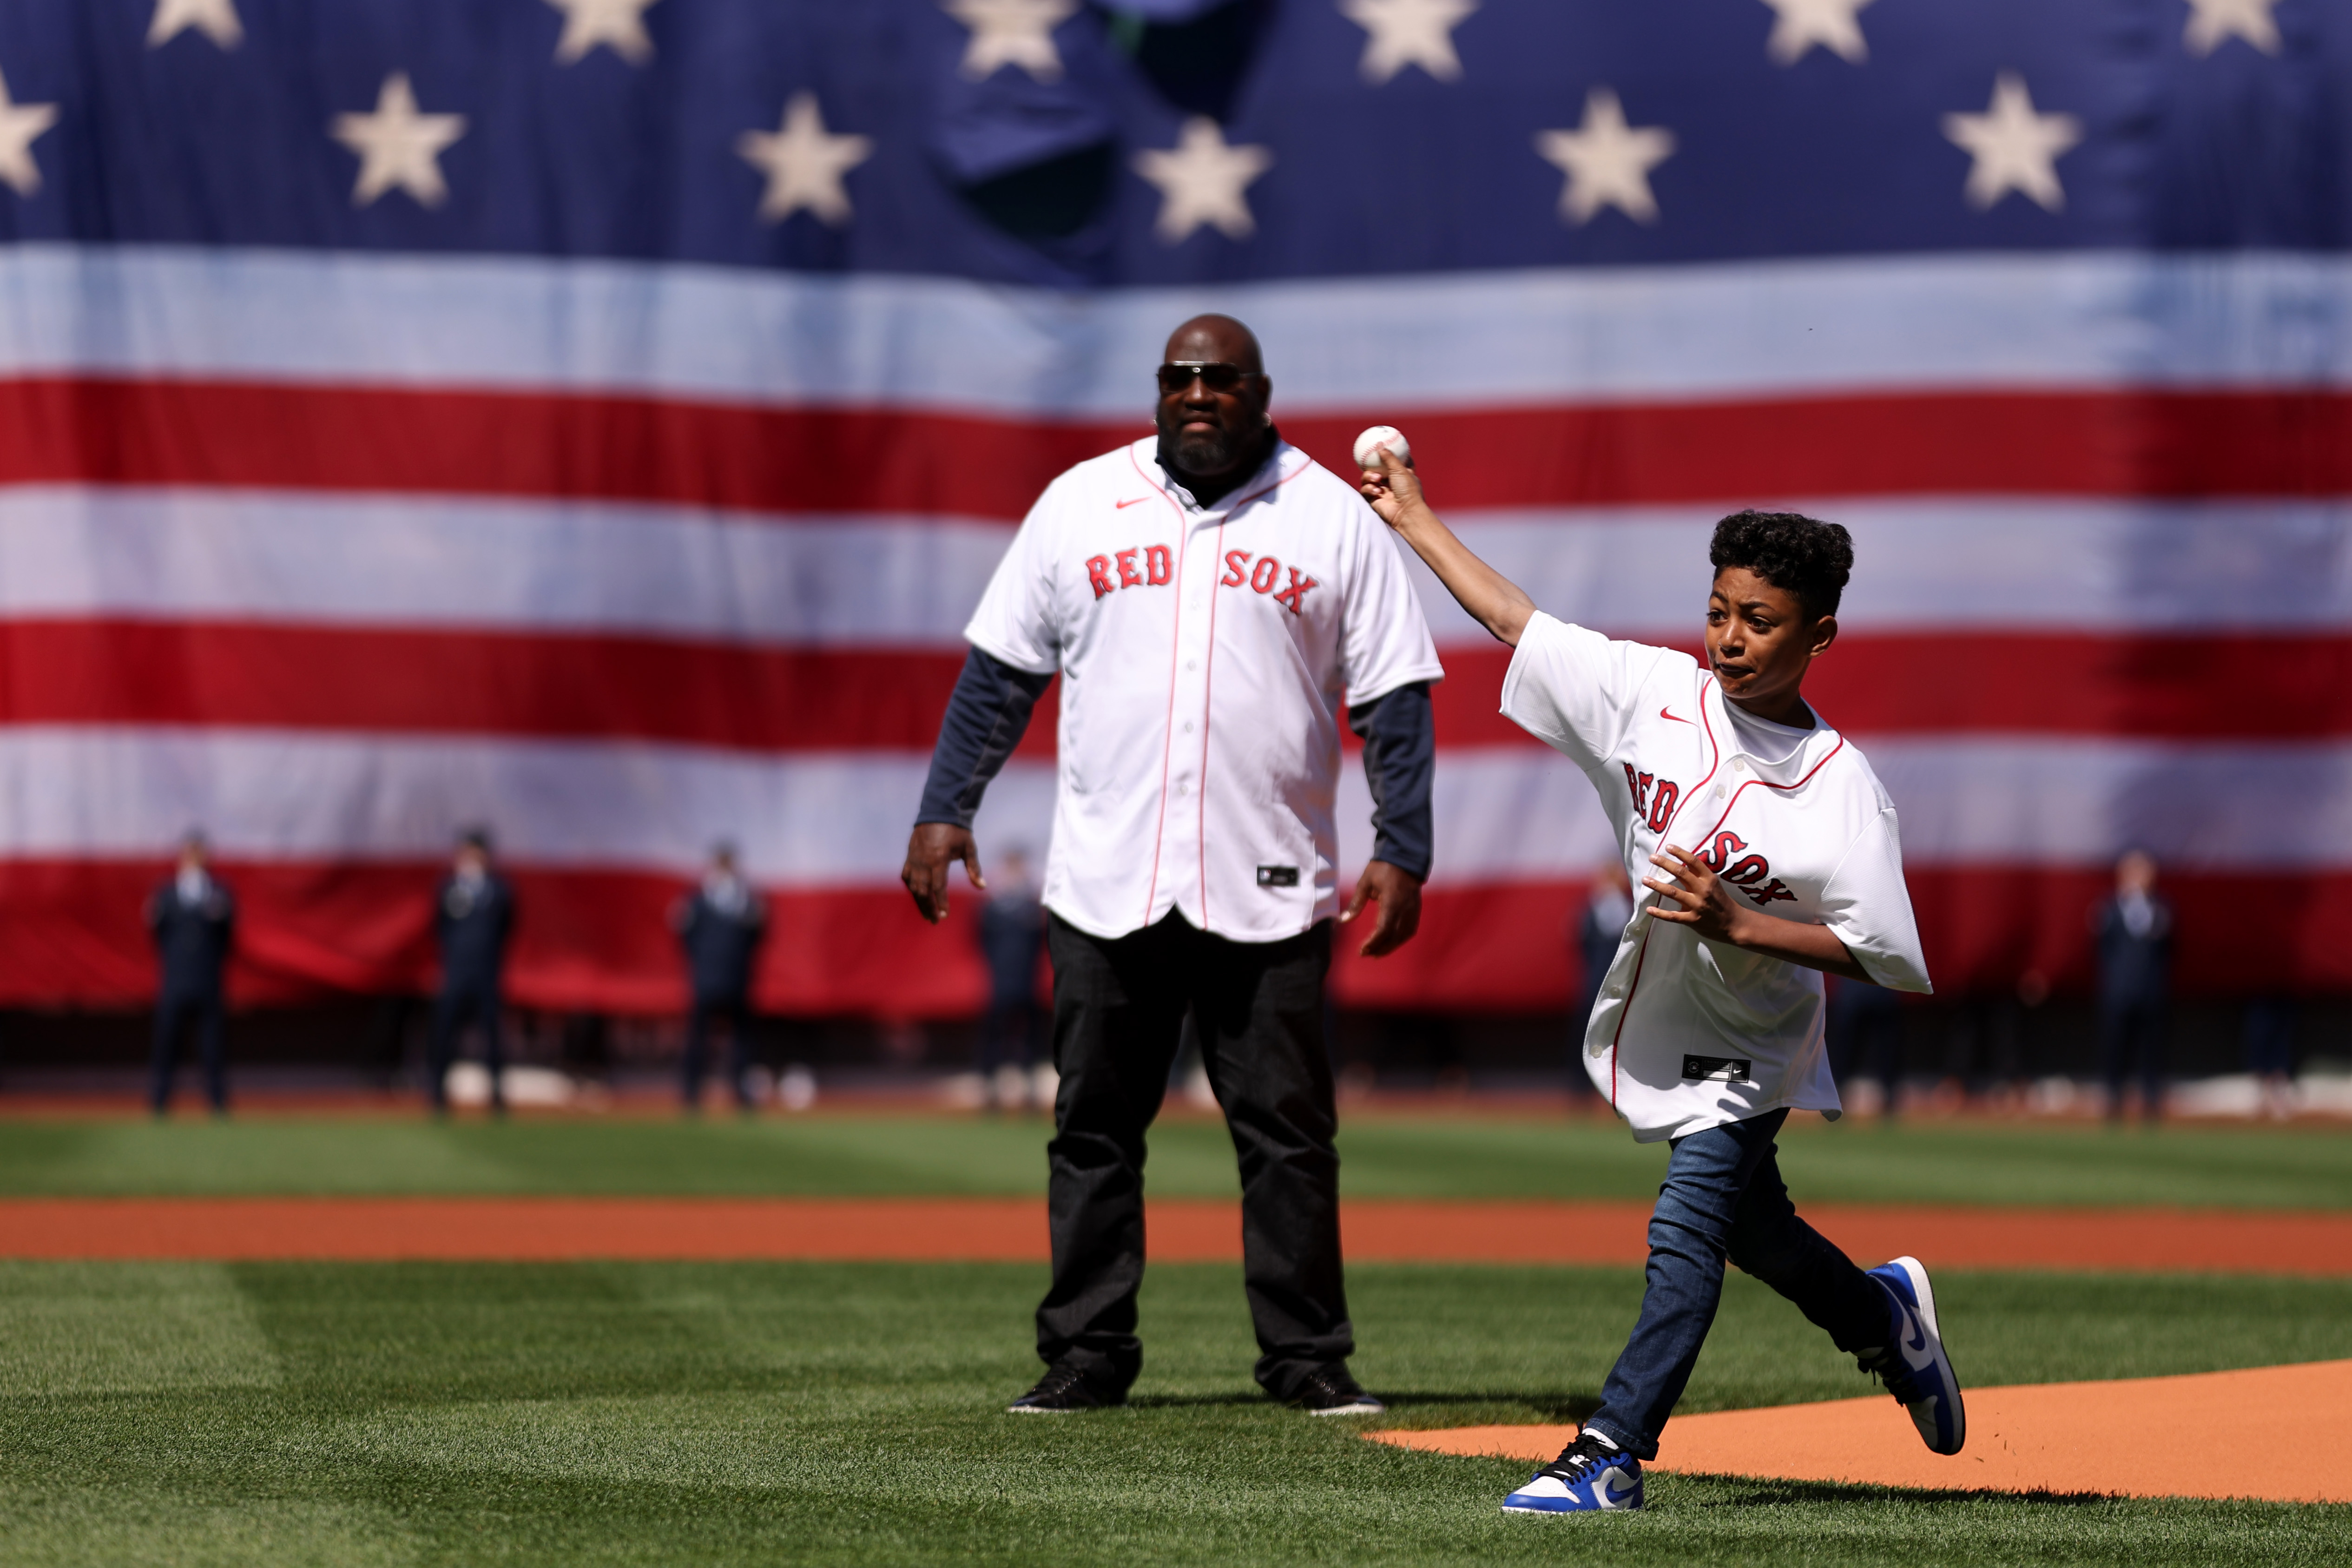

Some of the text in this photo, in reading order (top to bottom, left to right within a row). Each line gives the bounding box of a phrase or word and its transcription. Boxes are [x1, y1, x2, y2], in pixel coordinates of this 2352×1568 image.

[1086, 544, 1319, 616] RED SOX
[1623, 762, 1798, 906] RED SOX
